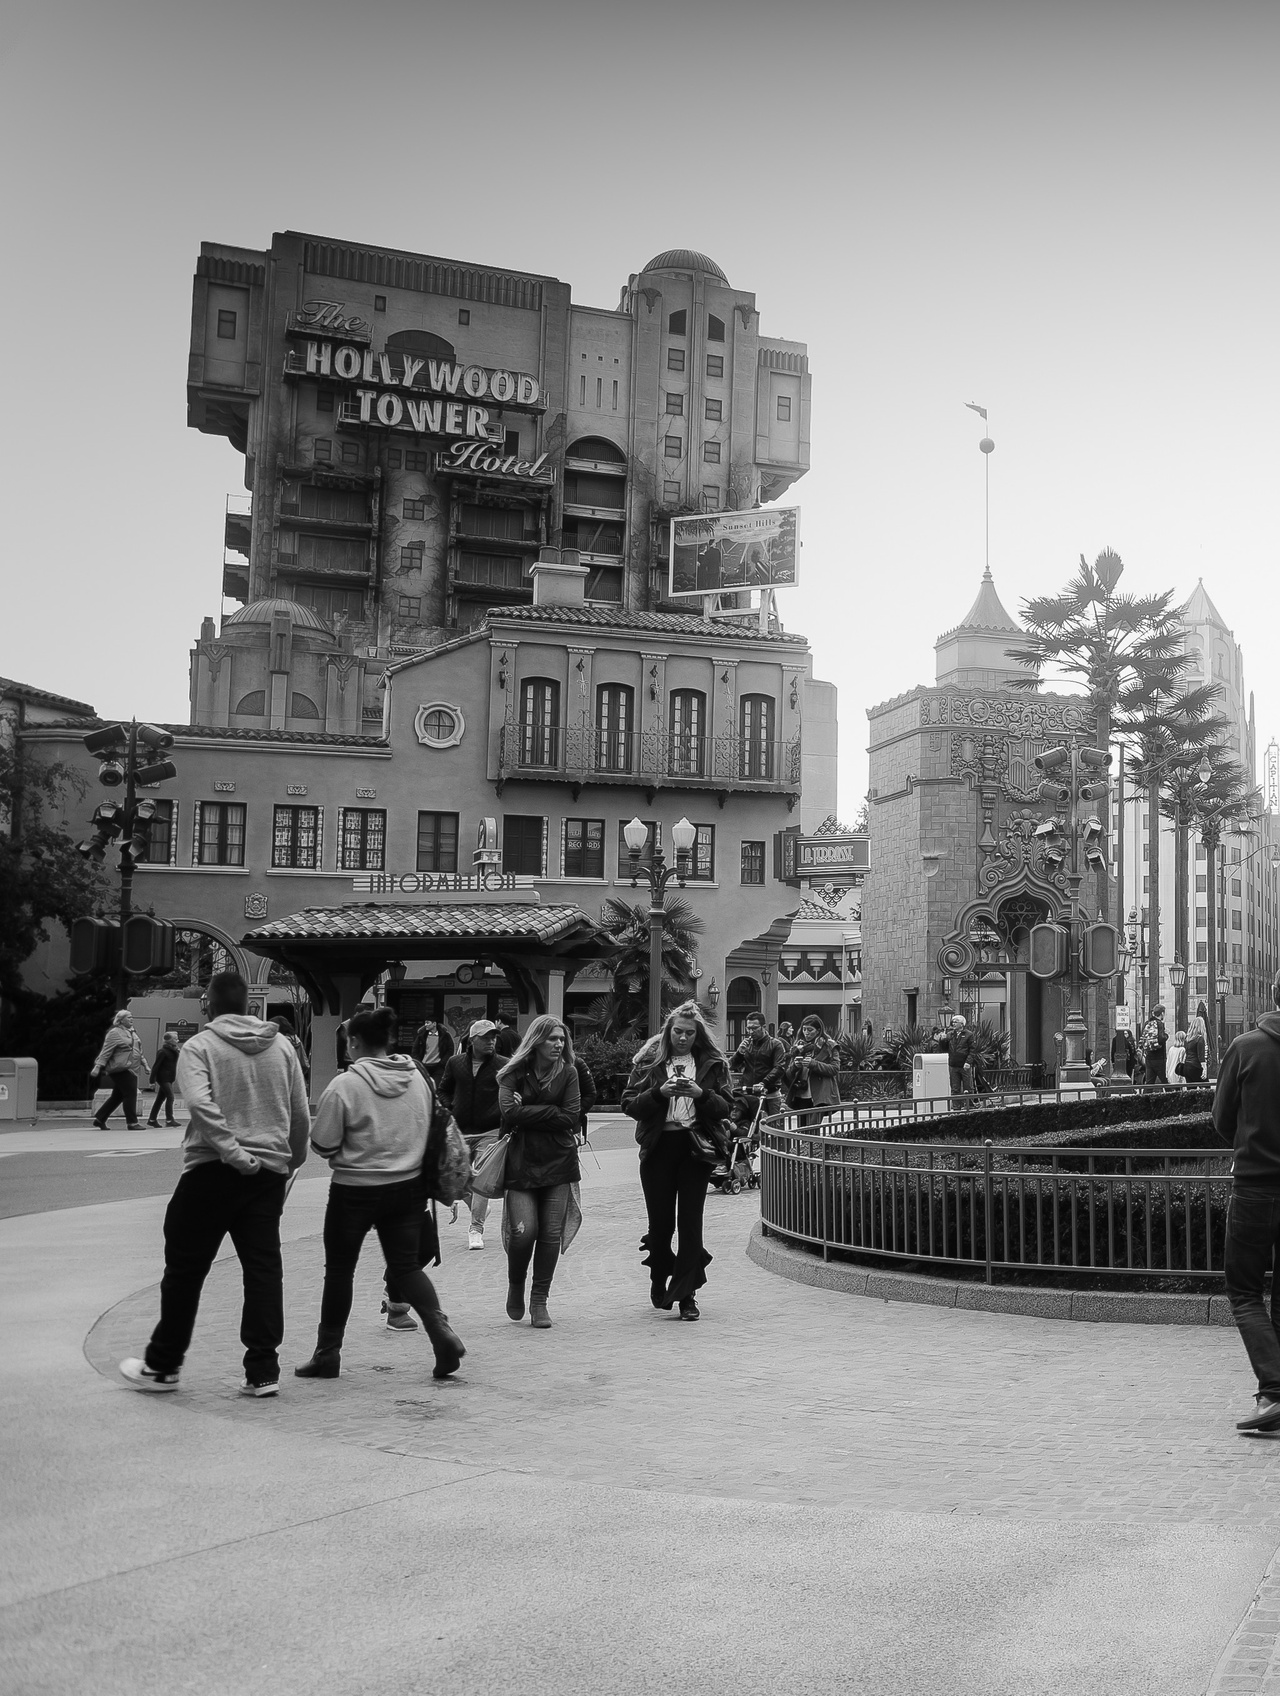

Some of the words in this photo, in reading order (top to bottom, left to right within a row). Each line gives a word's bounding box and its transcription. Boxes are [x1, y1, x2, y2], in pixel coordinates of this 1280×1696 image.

[297, 300, 367, 331] The
[306, 341, 540, 405] HOLLYWOOD
[356, 389, 489, 439] TOWER
[444, 441, 549, 477] Hotel
[722, 522, 752, 530] Sunset
[755, 519, 776, 527] Hills
[1269, 756, 1278, 806] CAPITAN
[800, 845, 812, 864] LA
[812, 845, 854, 865] TERRASSE
[369, 871, 516, 894] INFORMATION
